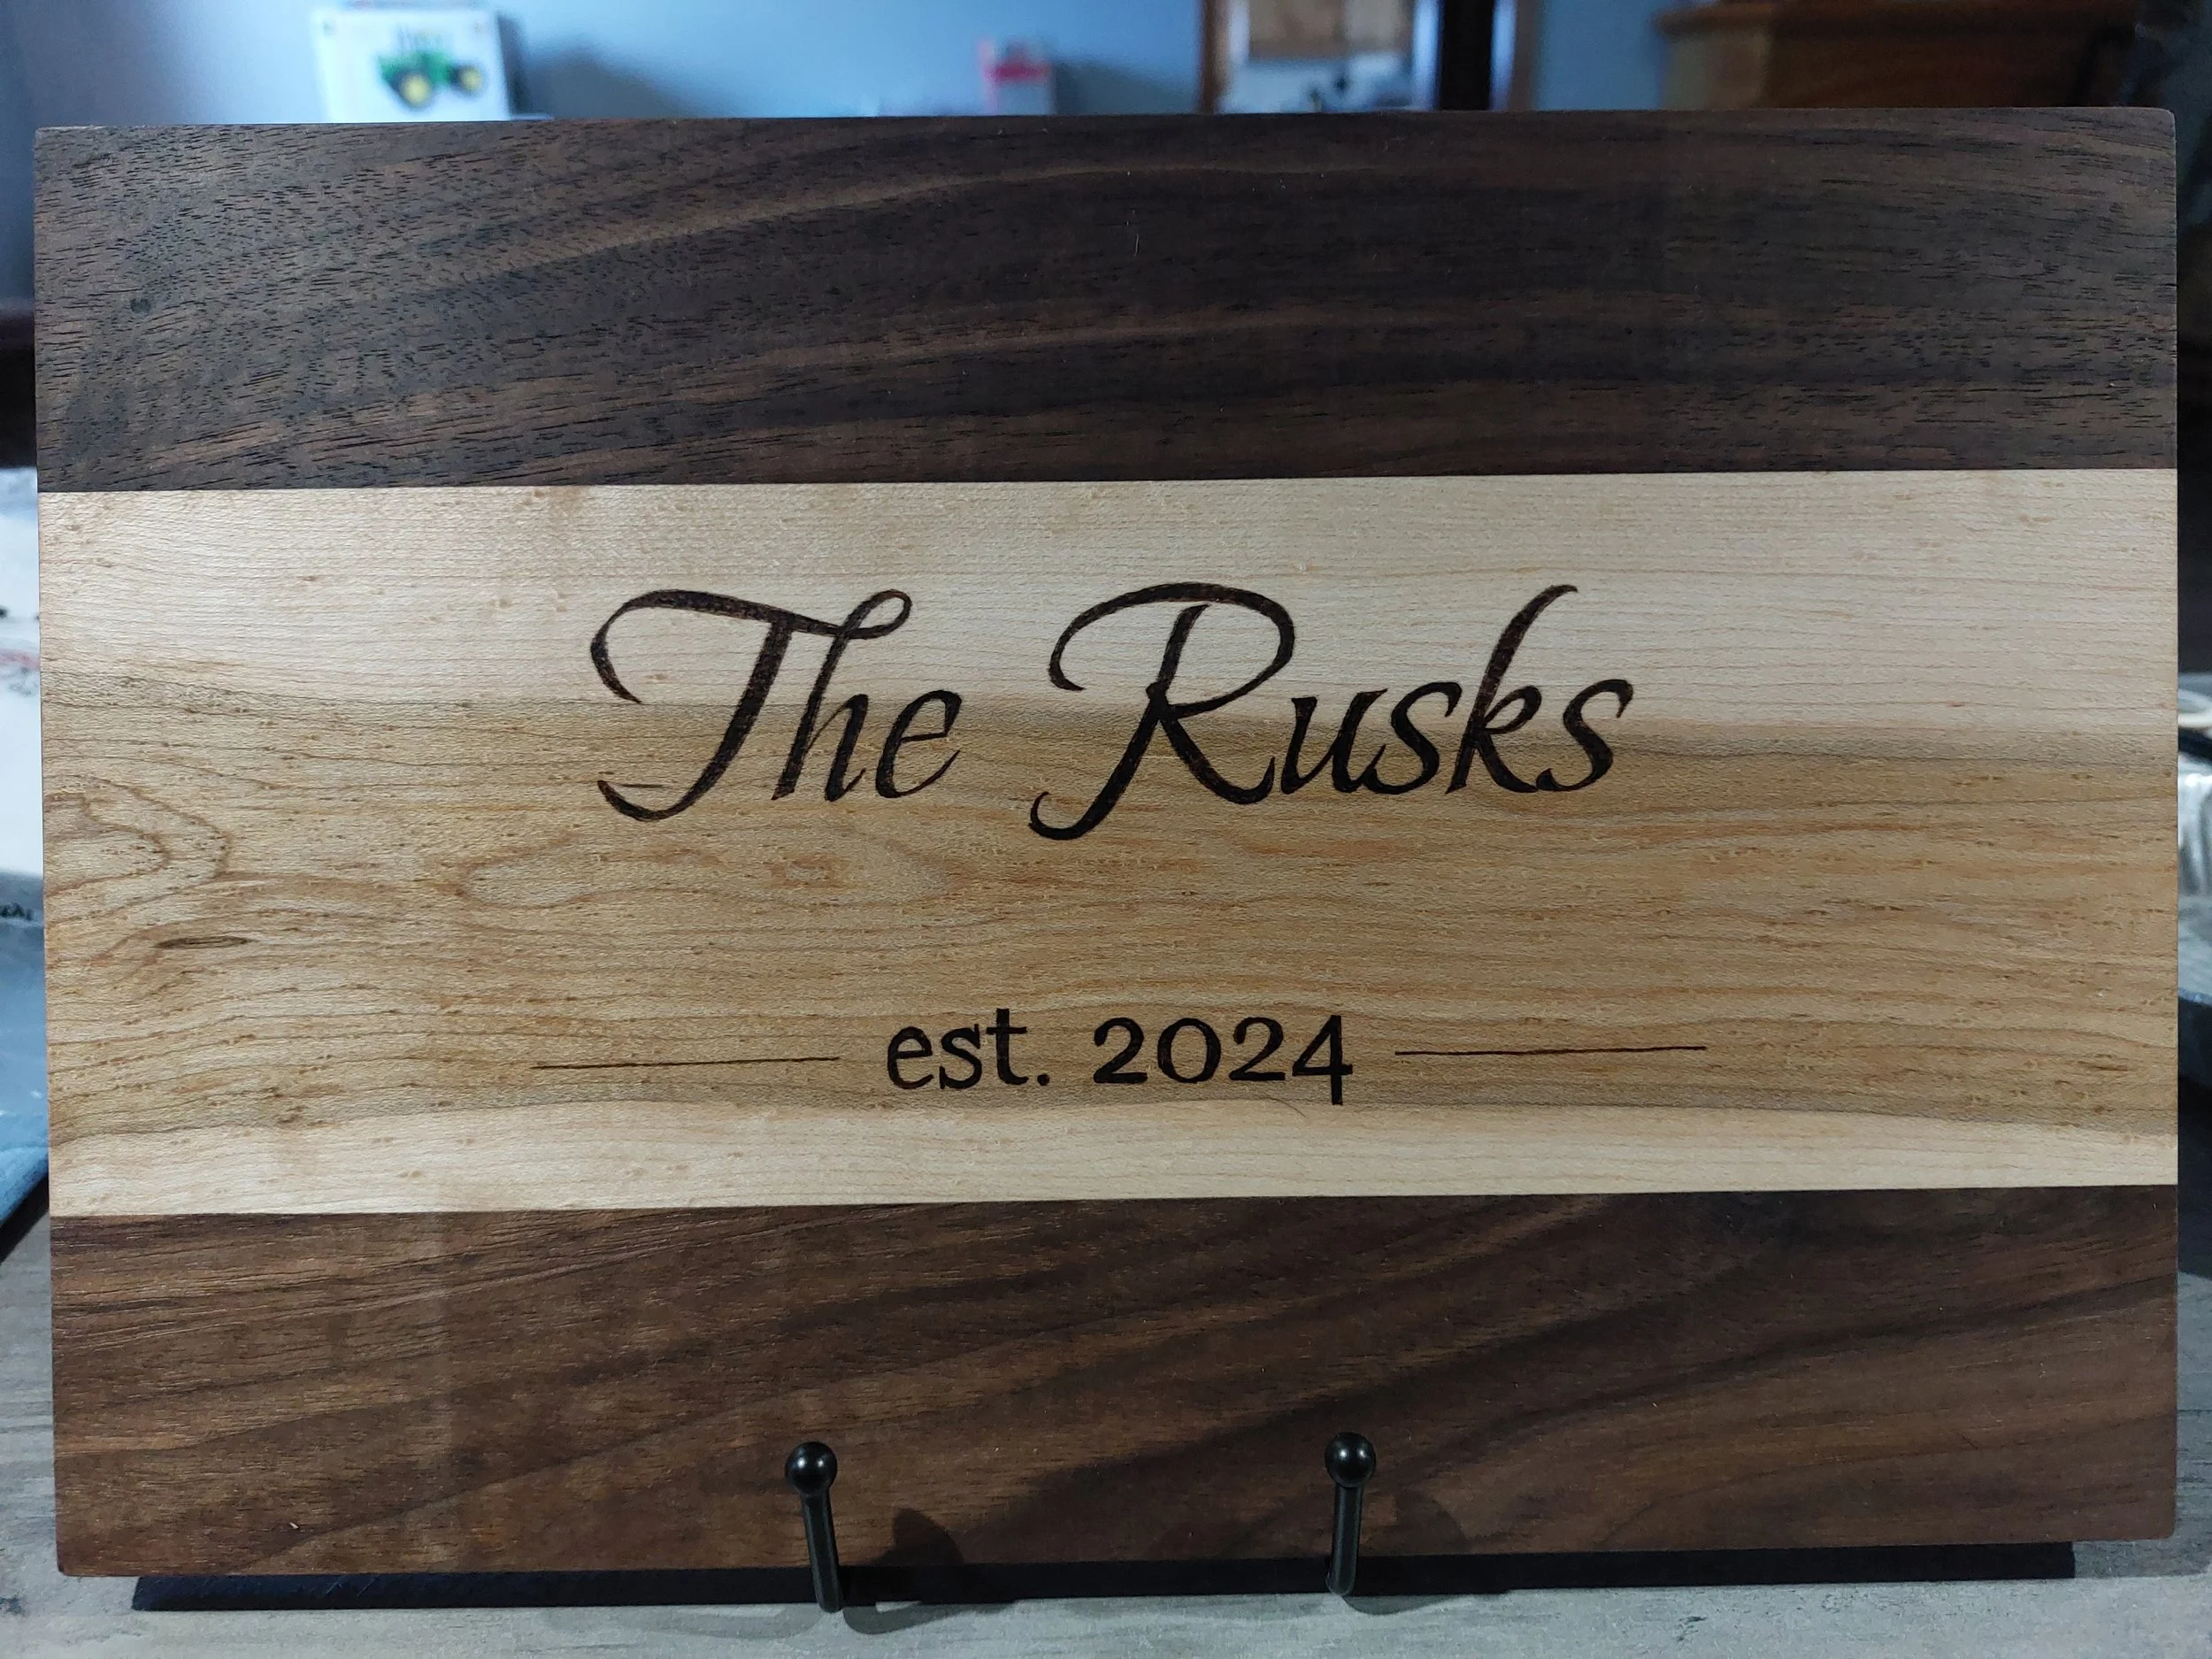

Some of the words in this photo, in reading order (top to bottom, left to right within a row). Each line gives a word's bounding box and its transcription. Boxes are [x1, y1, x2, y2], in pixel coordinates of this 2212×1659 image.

[589, 588, 964, 823] The
[1026, 581, 1635, 841] Rusks
[886, 1007, 1051, 1093] est.
[1092, 1013, 1353, 1107] 2024
